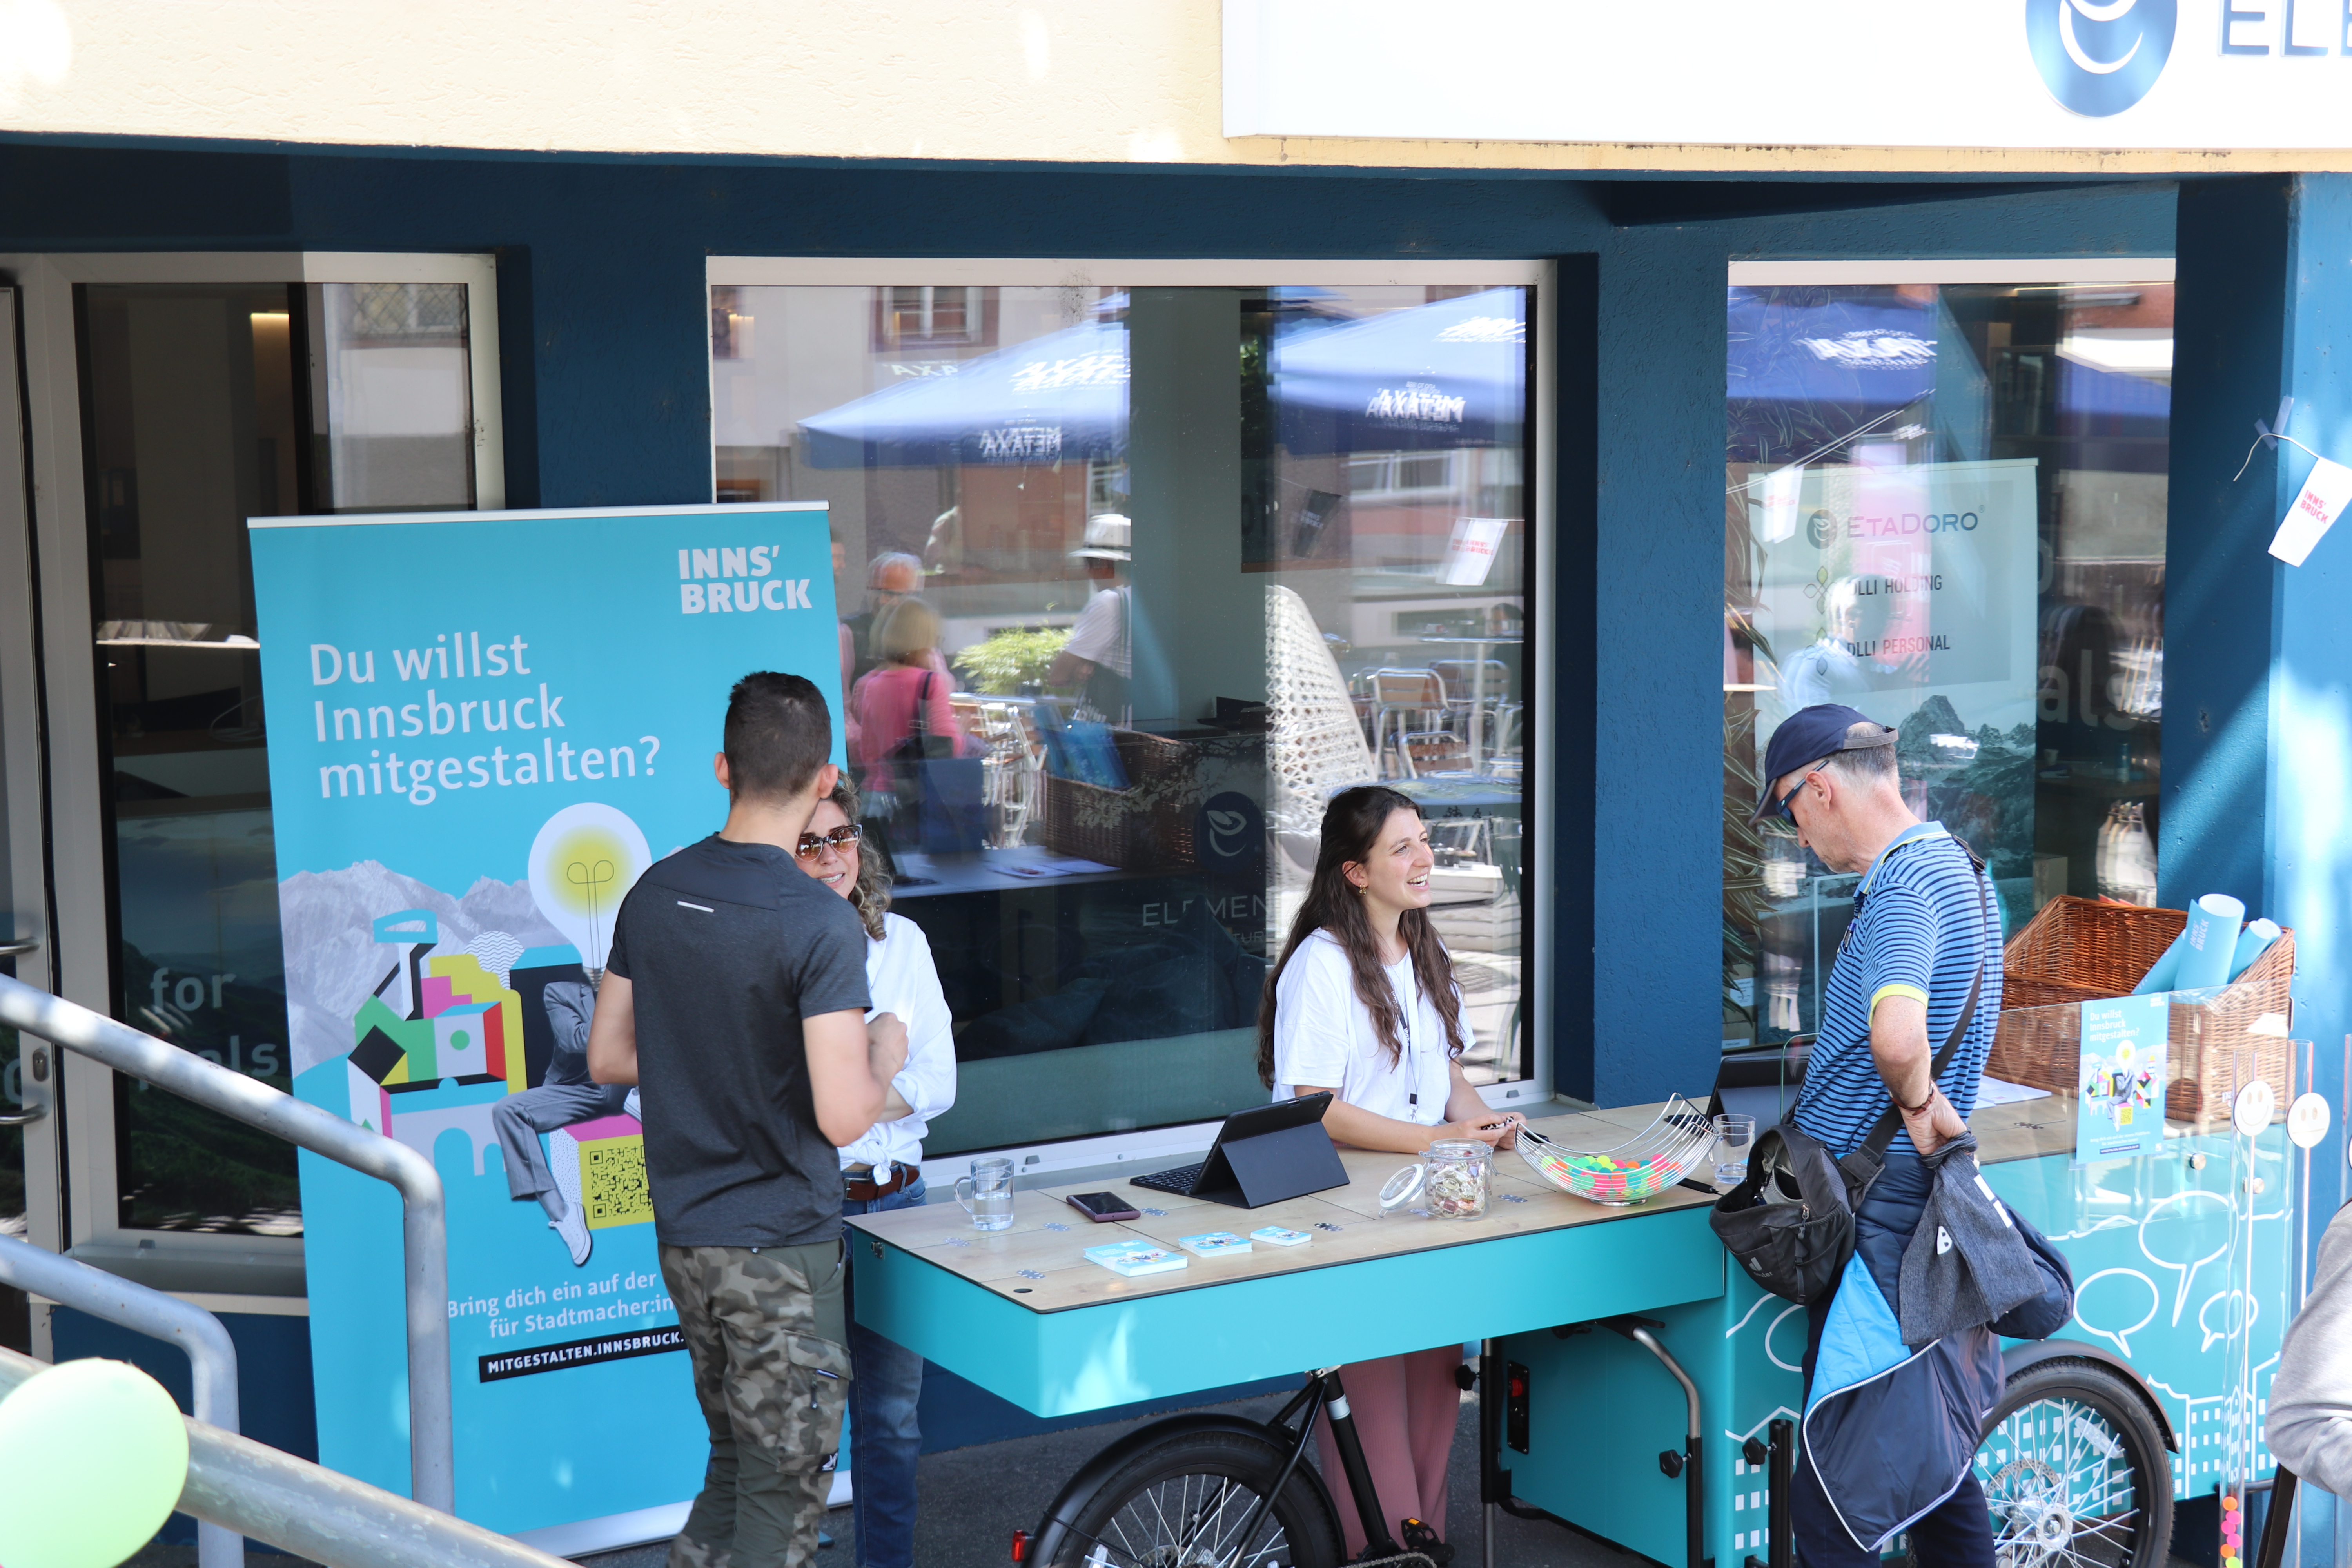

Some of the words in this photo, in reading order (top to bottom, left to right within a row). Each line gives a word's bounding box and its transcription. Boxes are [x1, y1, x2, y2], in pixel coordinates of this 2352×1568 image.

[2219, 0, 2352, 57] EL
[2299, 499, 2329, 524] BRUCK
[679, 545, 780, 579] INNS'
[681, 579, 813, 614] BRUCK
[1885, 575, 1942, 594] HOLDING
[310, 644, 375, 686] Du
[392, 631, 531, 681] willst
[1883, 635, 1950, 655] PERSONAL
[315, 682, 566, 742] Innsbruck
[320, 735, 660, 806] mitgestalten?
[2195, 918, 2209, 951] BRUCK
[150, 967, 237, 1012] for
[2090, 1013, 2100, 1021] Du
[2101, 1009, 2122, 1020] willst
[2090, 1018, 2126, 1031] Innsbruck
[2089, 1027, 2140, 1043] mitgestalten?
[448, 1296, 500, 1318] Bring
[505, 1285, 546, 1309] dich
[552, 1281, 582, 1301] ein
[588, 1273, 620, 1296] auf
[624, 1271, 657, 1290] der
[489, 1318, 519, 1338] für
